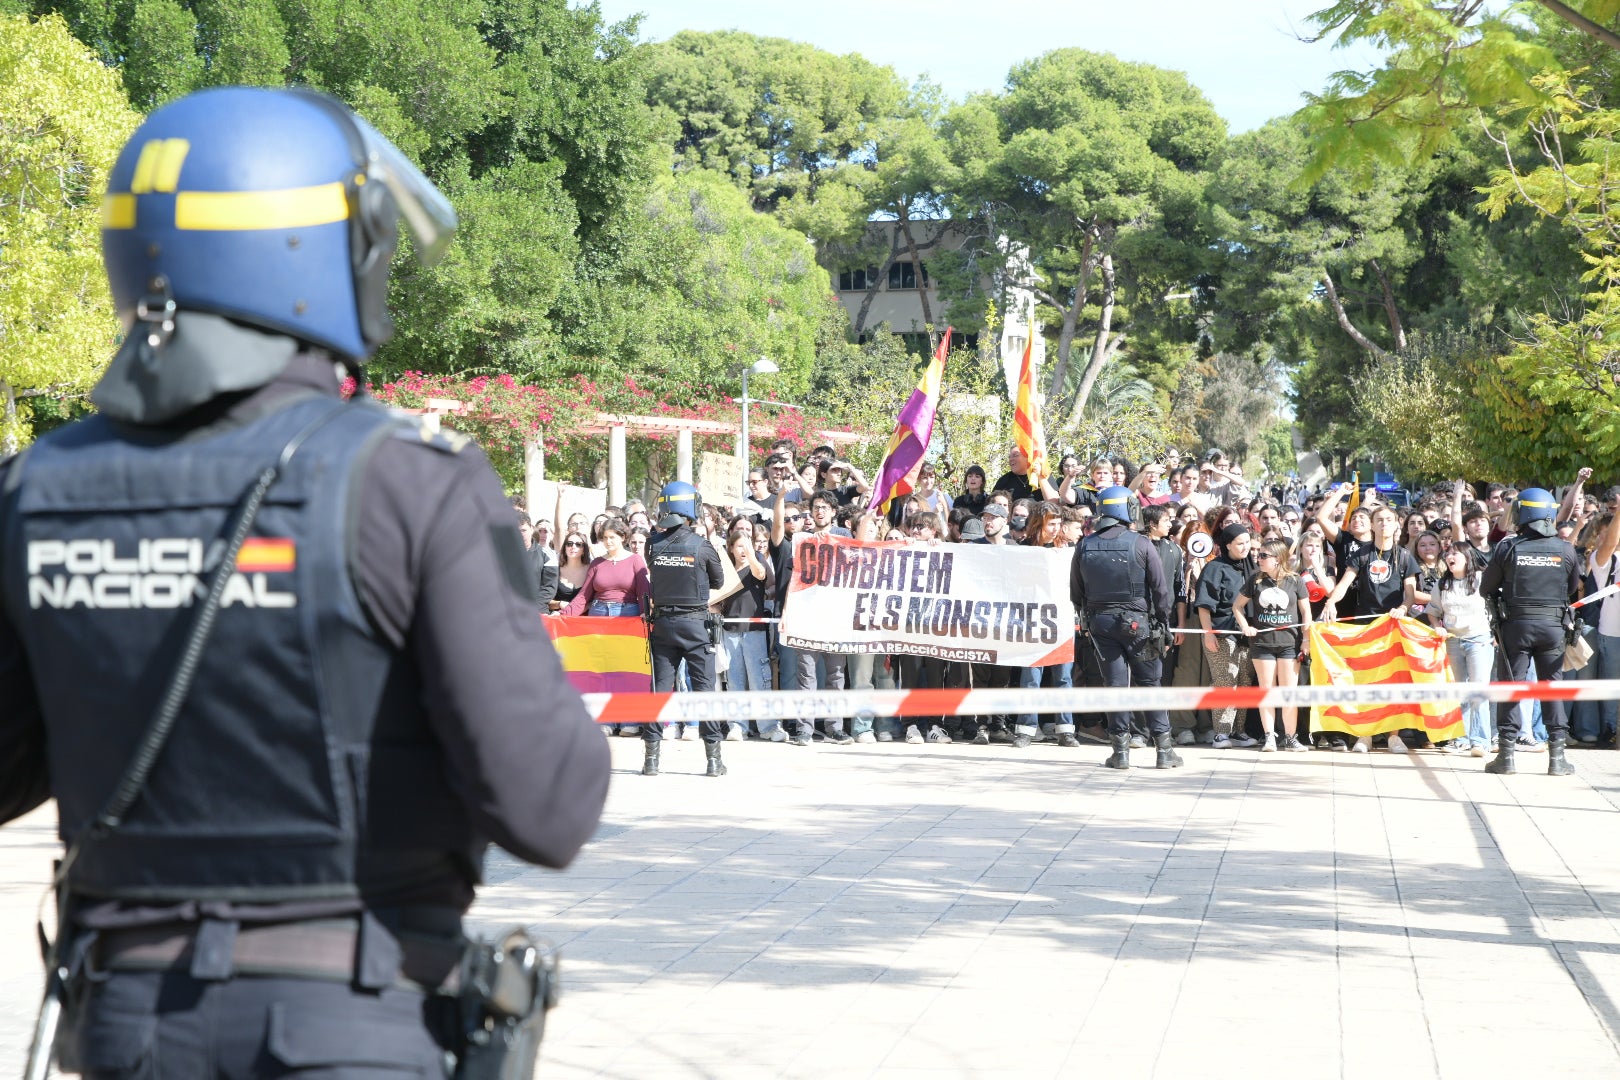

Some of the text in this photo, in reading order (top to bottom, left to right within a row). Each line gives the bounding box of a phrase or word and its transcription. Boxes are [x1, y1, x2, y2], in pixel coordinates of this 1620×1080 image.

[654, 560, 695, 568] NACIONAL
[799, 542, 954, 595] COMBATEM
[1516, 560, 1561, 568] NACIONAL
[852, 592, 1058, 644] ELS MONSTRES
[840, 642, 867, 653] AMB
[868, 642, 885, 653] LA
[886, 642, 938, 656] REACCIÓ
[940, 648, 991, 662] RACISTA
